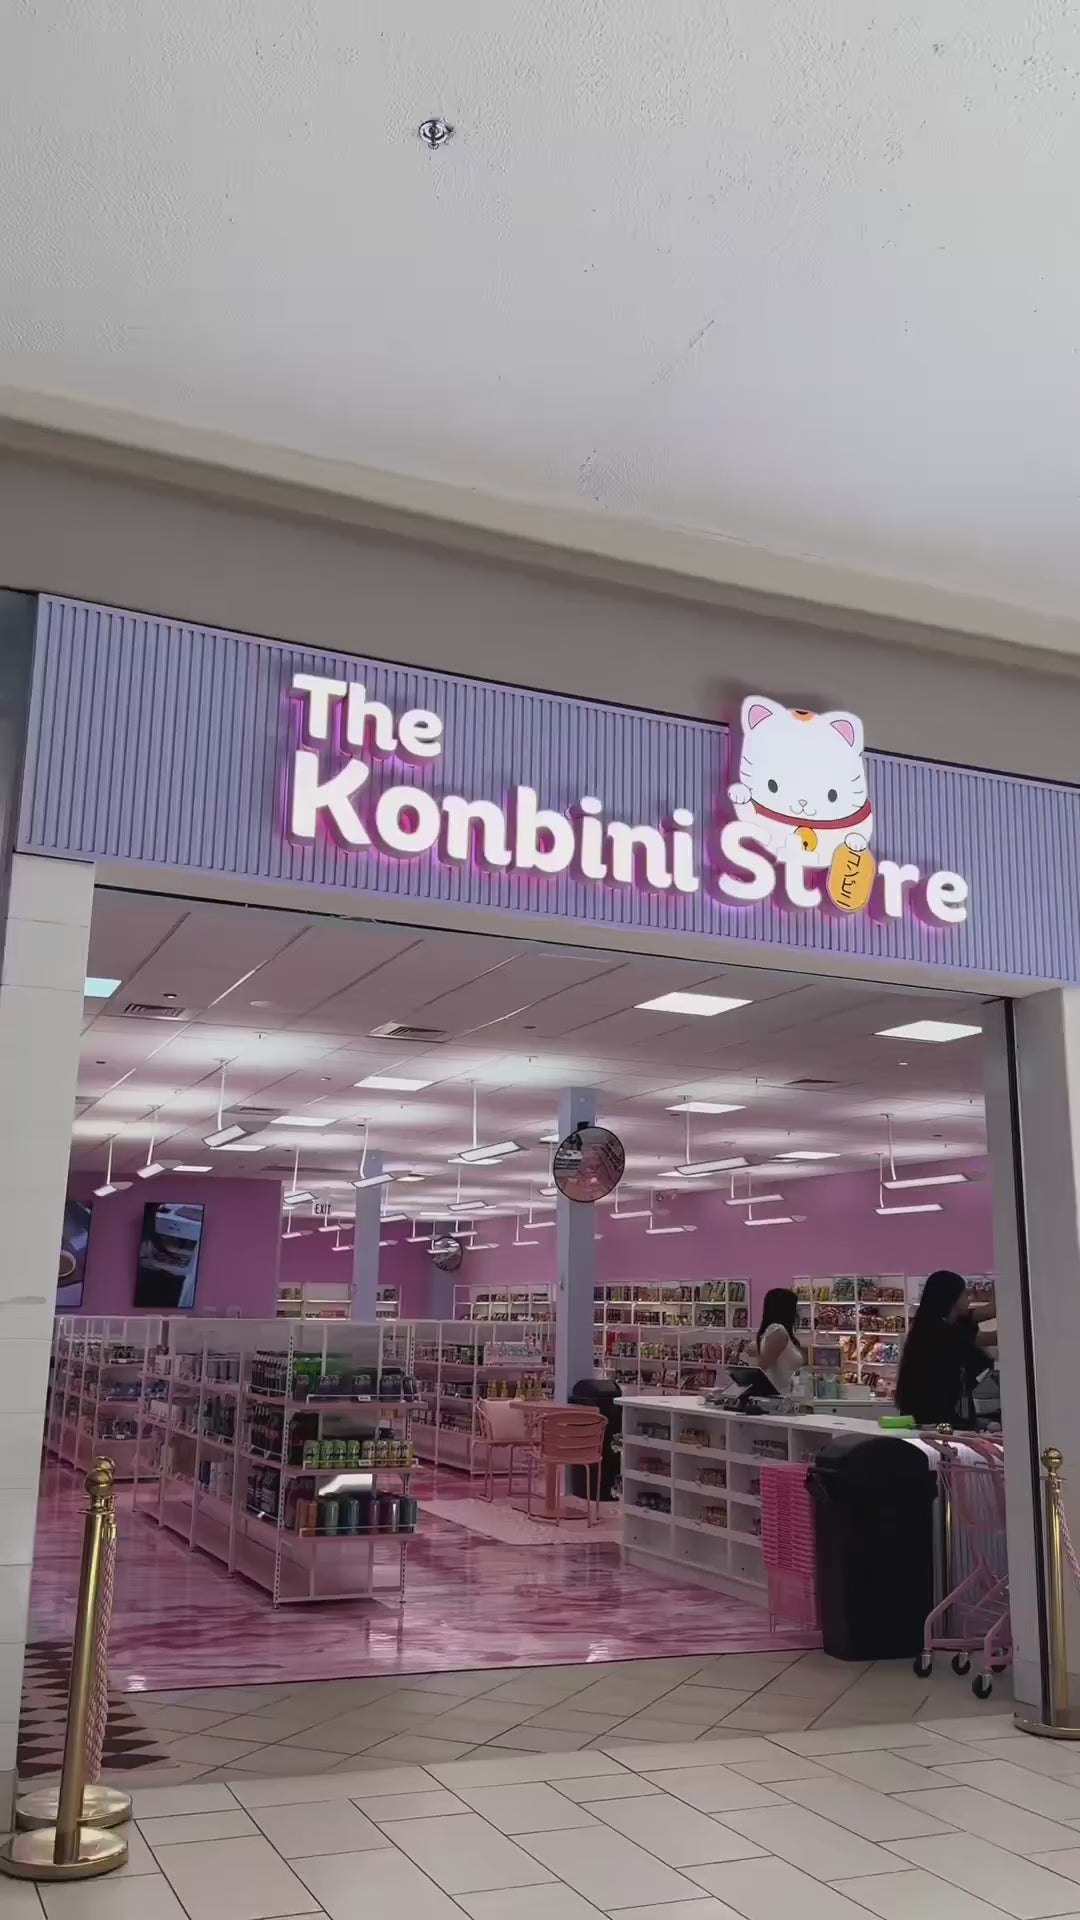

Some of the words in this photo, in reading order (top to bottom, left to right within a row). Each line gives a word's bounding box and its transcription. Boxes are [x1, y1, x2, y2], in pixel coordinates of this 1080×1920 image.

[293, 673, 443, 757] The
[291, 749, 699, 893] Konbini
[314, 1203, 332, 1215] EXIT
